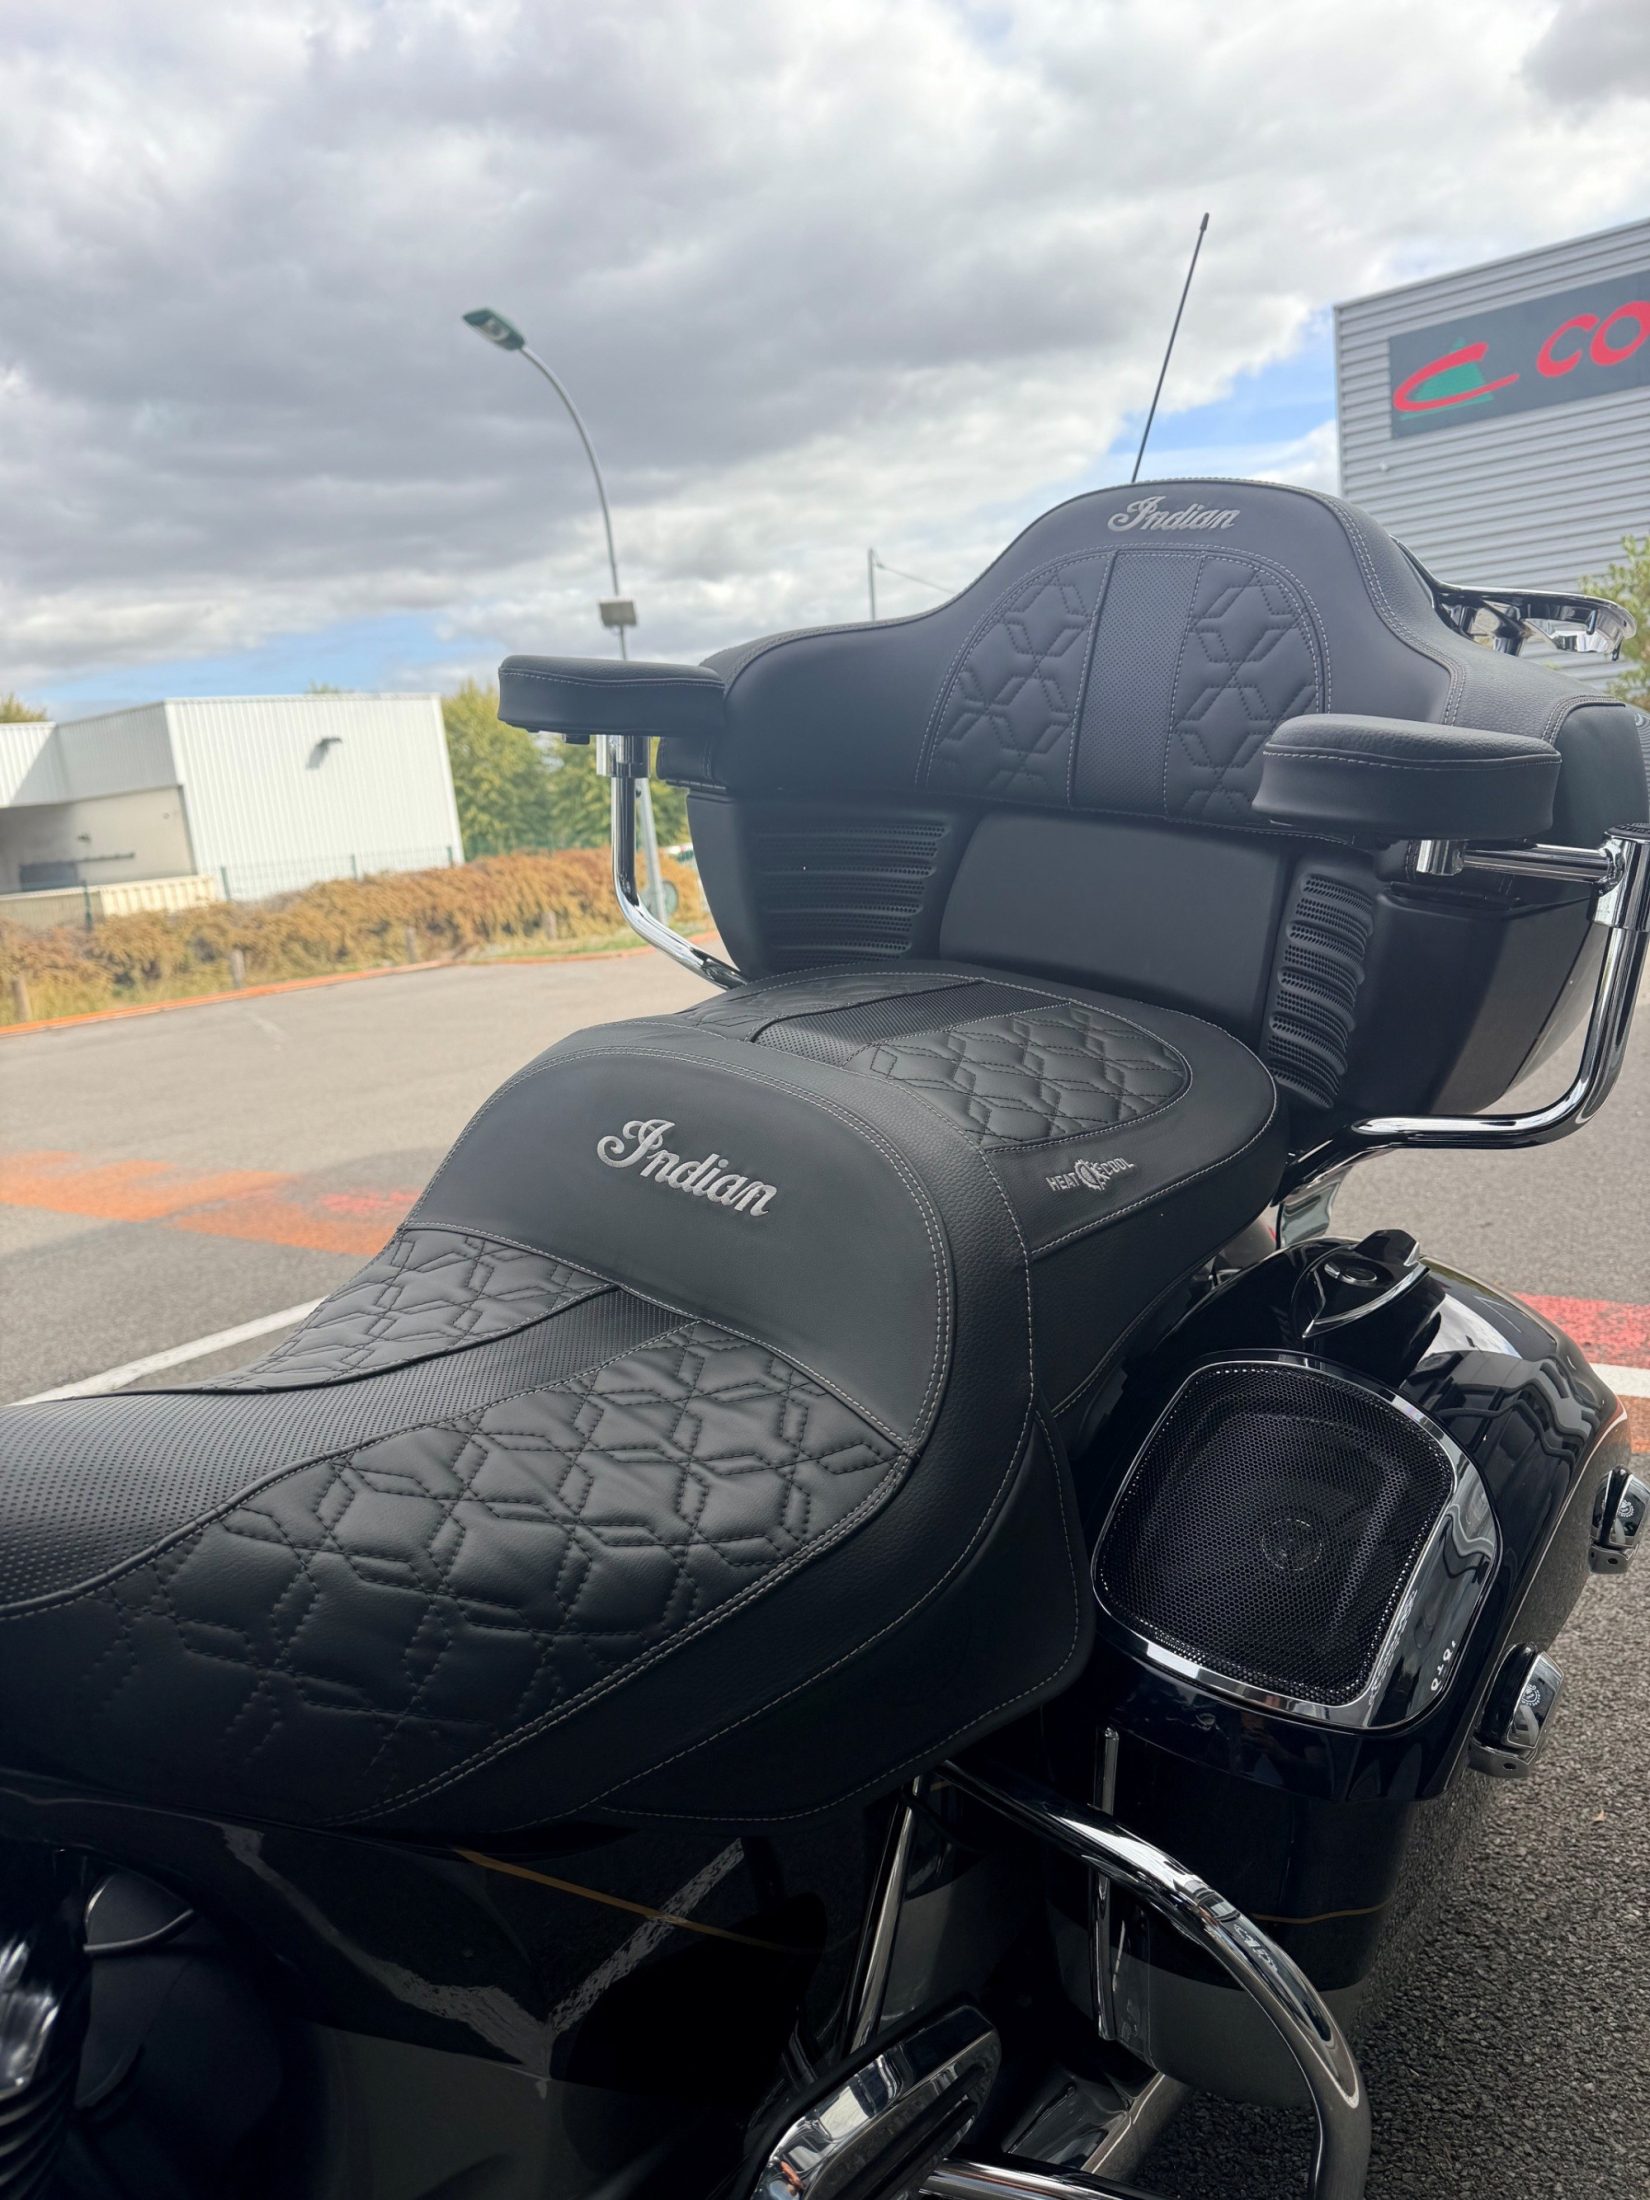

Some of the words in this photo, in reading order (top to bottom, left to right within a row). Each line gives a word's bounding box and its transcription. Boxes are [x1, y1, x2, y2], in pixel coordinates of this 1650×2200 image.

[1107, 495, 1241, 532] Indian
[597, 1118, 778, 1217] Indian
[1045, 1172, 1080, 1191] HEAT
[1100, 1157, 1135, 1176] COOL
